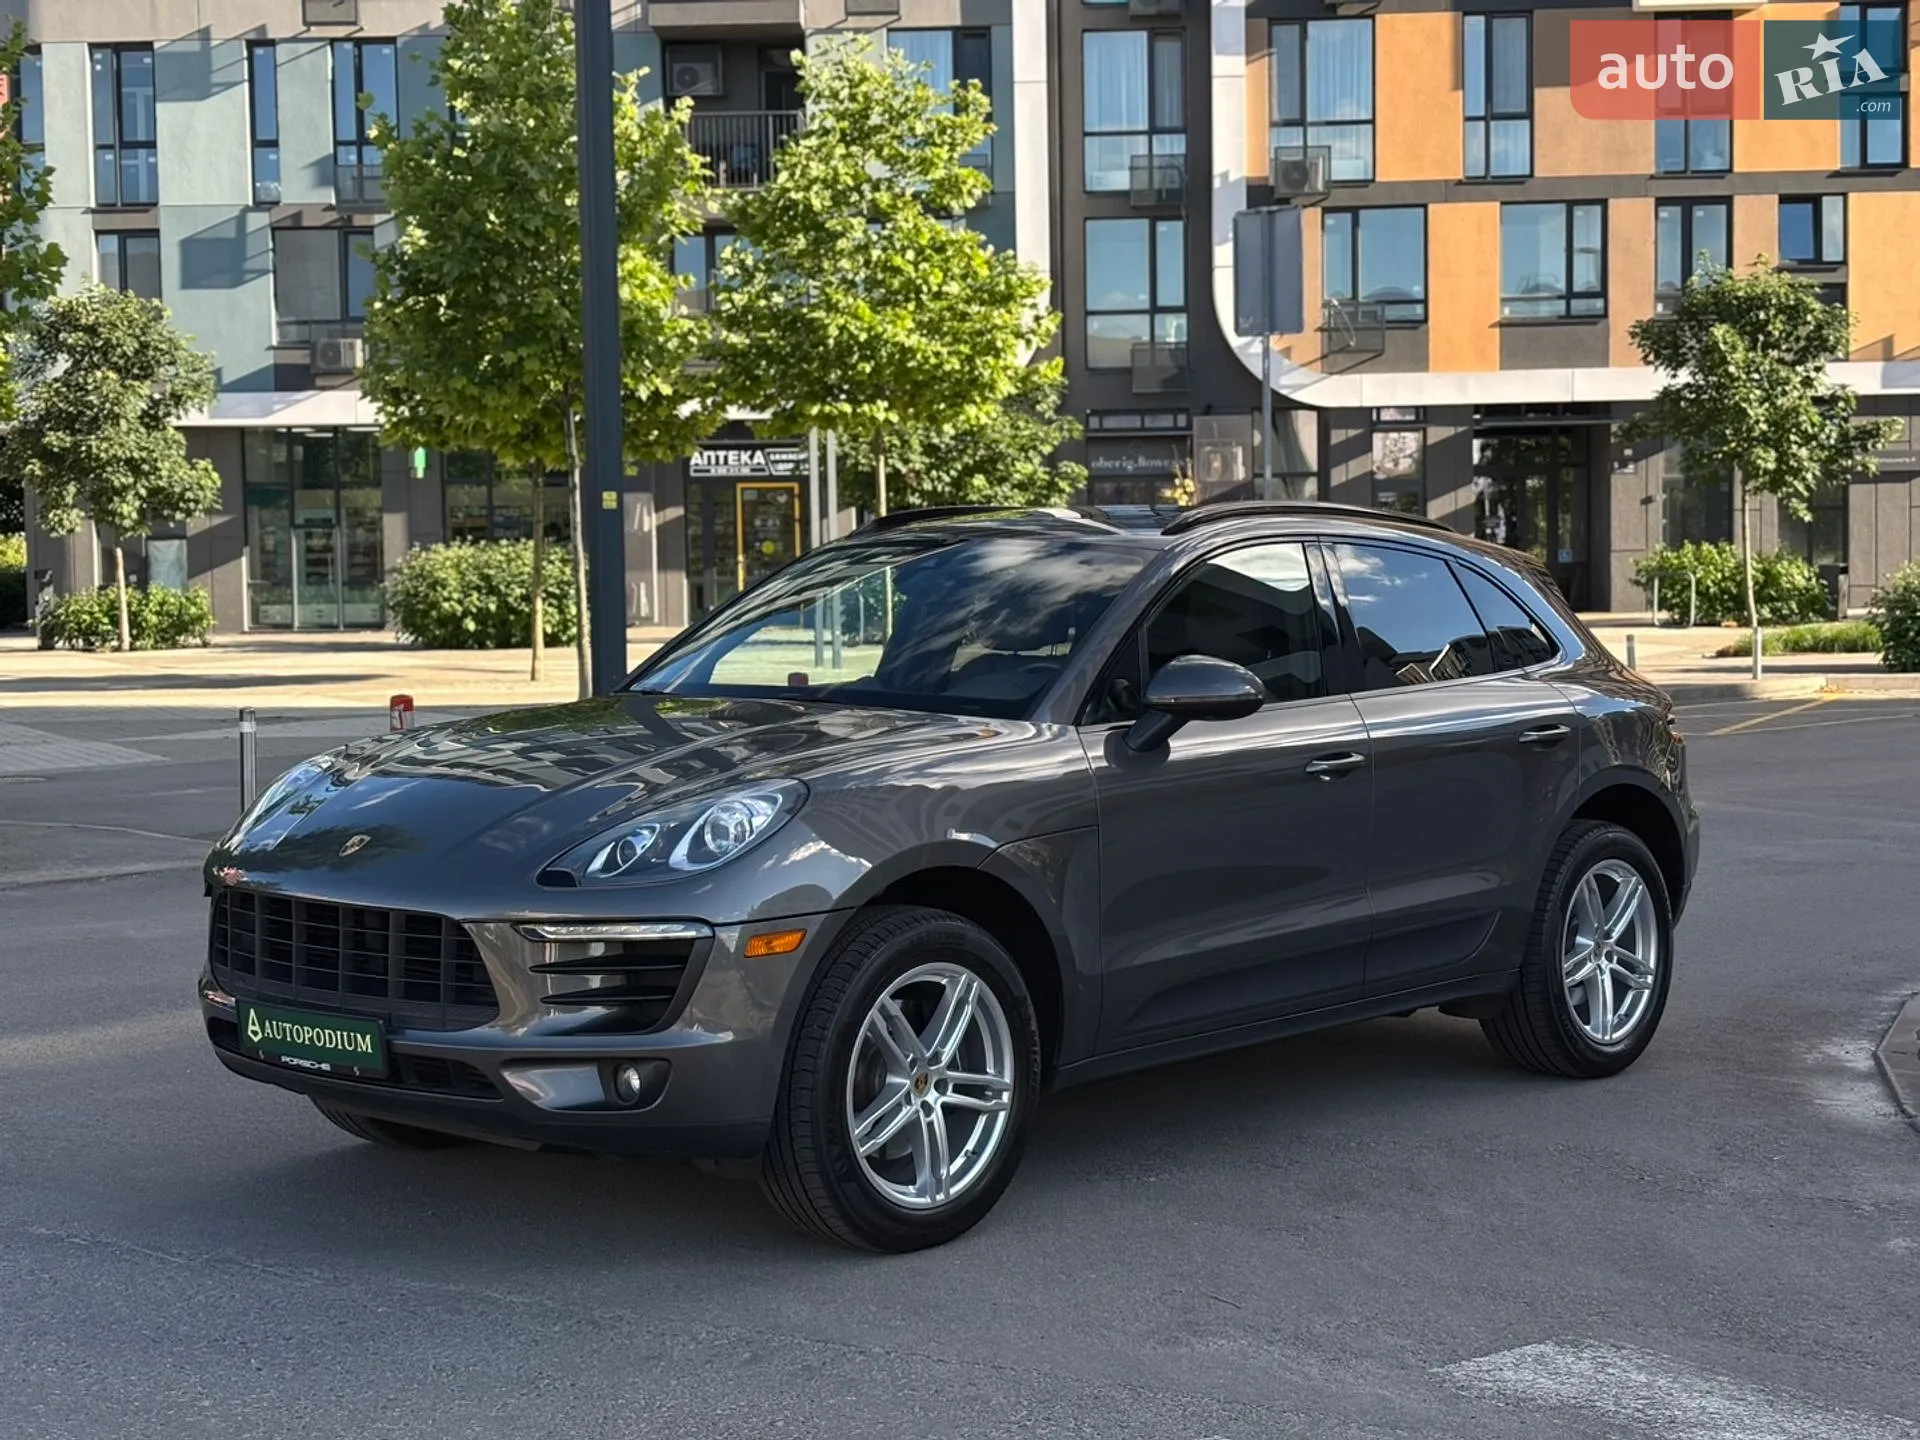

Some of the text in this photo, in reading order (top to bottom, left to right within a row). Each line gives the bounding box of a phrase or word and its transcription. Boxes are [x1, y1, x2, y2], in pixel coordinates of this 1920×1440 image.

[689, 450, 766, 466] АПТЕКА
[1091, 456, 1185, 473] oberig.flowe
[264, 1019, 373, 1053] AUTOPODIUM
[281, 1055, 331, 1071] PORSCHE
